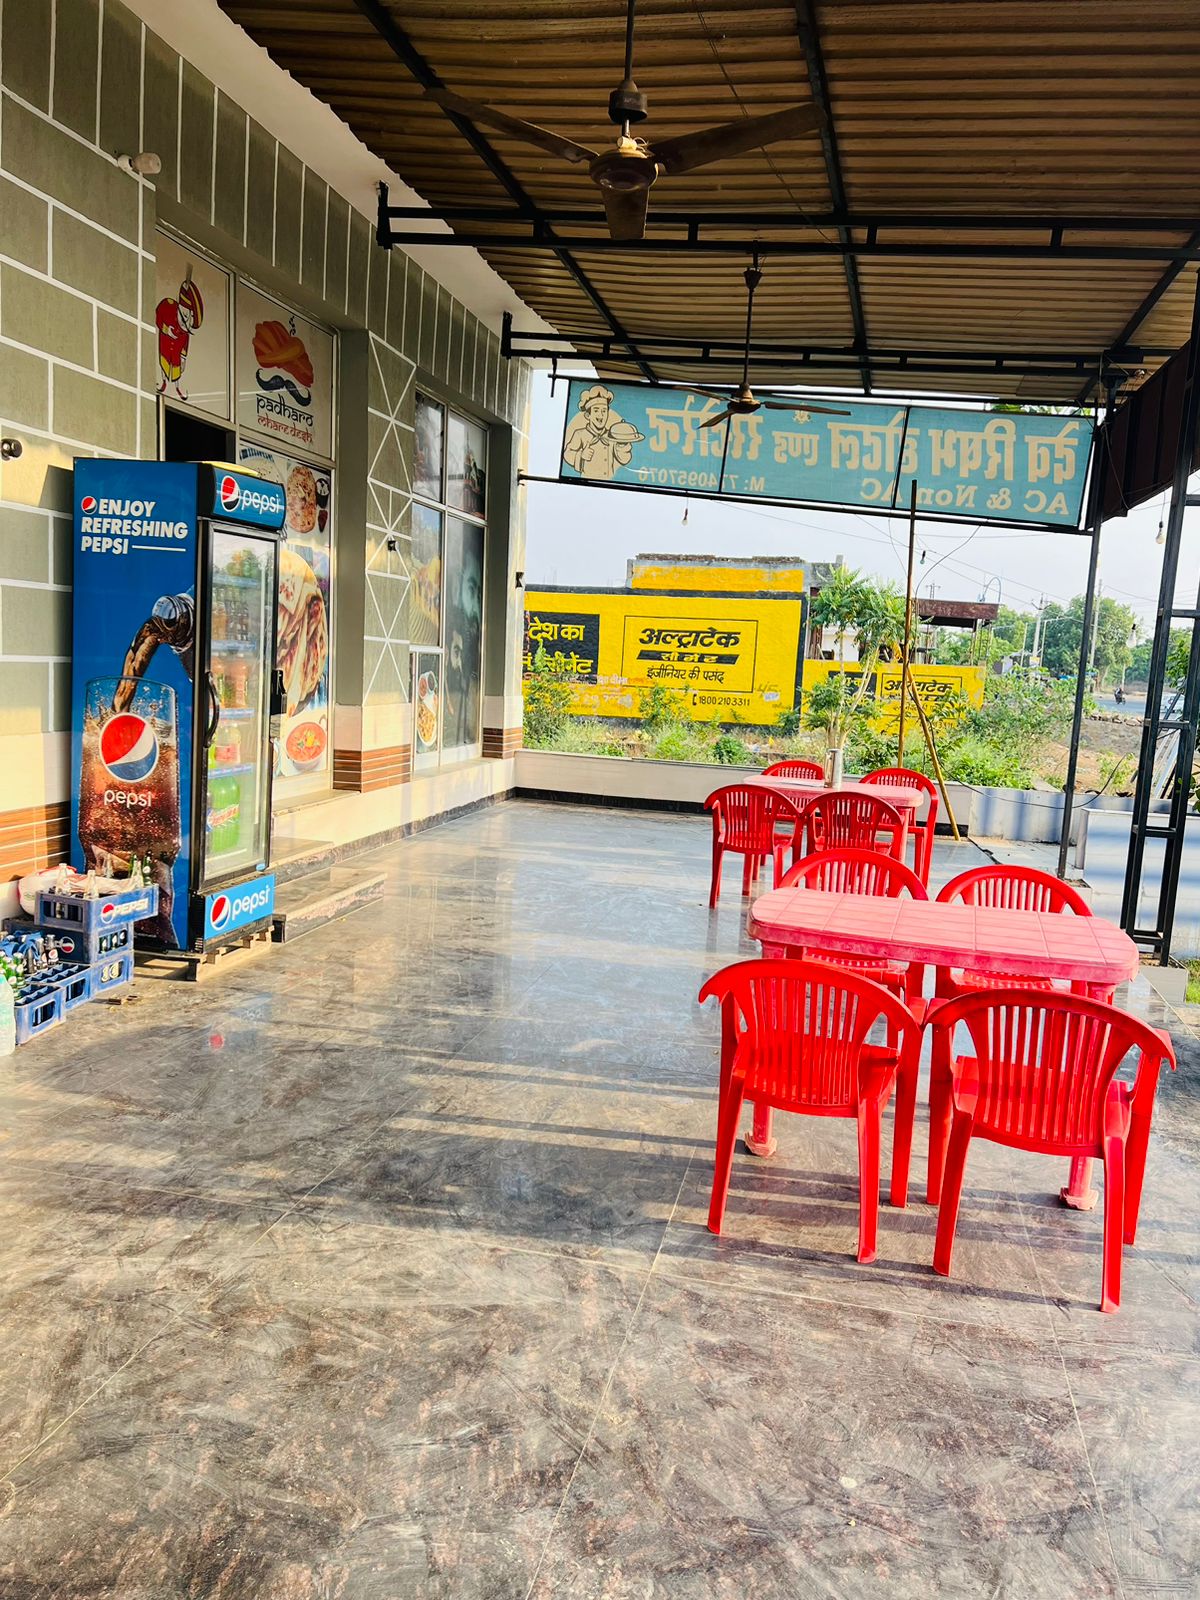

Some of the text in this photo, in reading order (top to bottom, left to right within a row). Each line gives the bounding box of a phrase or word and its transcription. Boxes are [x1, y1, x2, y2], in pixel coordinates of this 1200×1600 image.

[256, 393, 314, 427] padharo
[99, 499, 156, 518] ENJOY
[241, 490, 280, 514] pepsi
[81, 517, 188, 539] REFRESHING
[80, 535, 129, 555] PEPSI
[561, 624, 585, 641] का
[639, 627, 741, 648] अल्ट्राटेक
[688, 666, 701, 681] की
[104, 788, 153, 809] pepsi
[113, 897, 149, 916] PEPSI
[232, 885, 270, 921] pepsi
